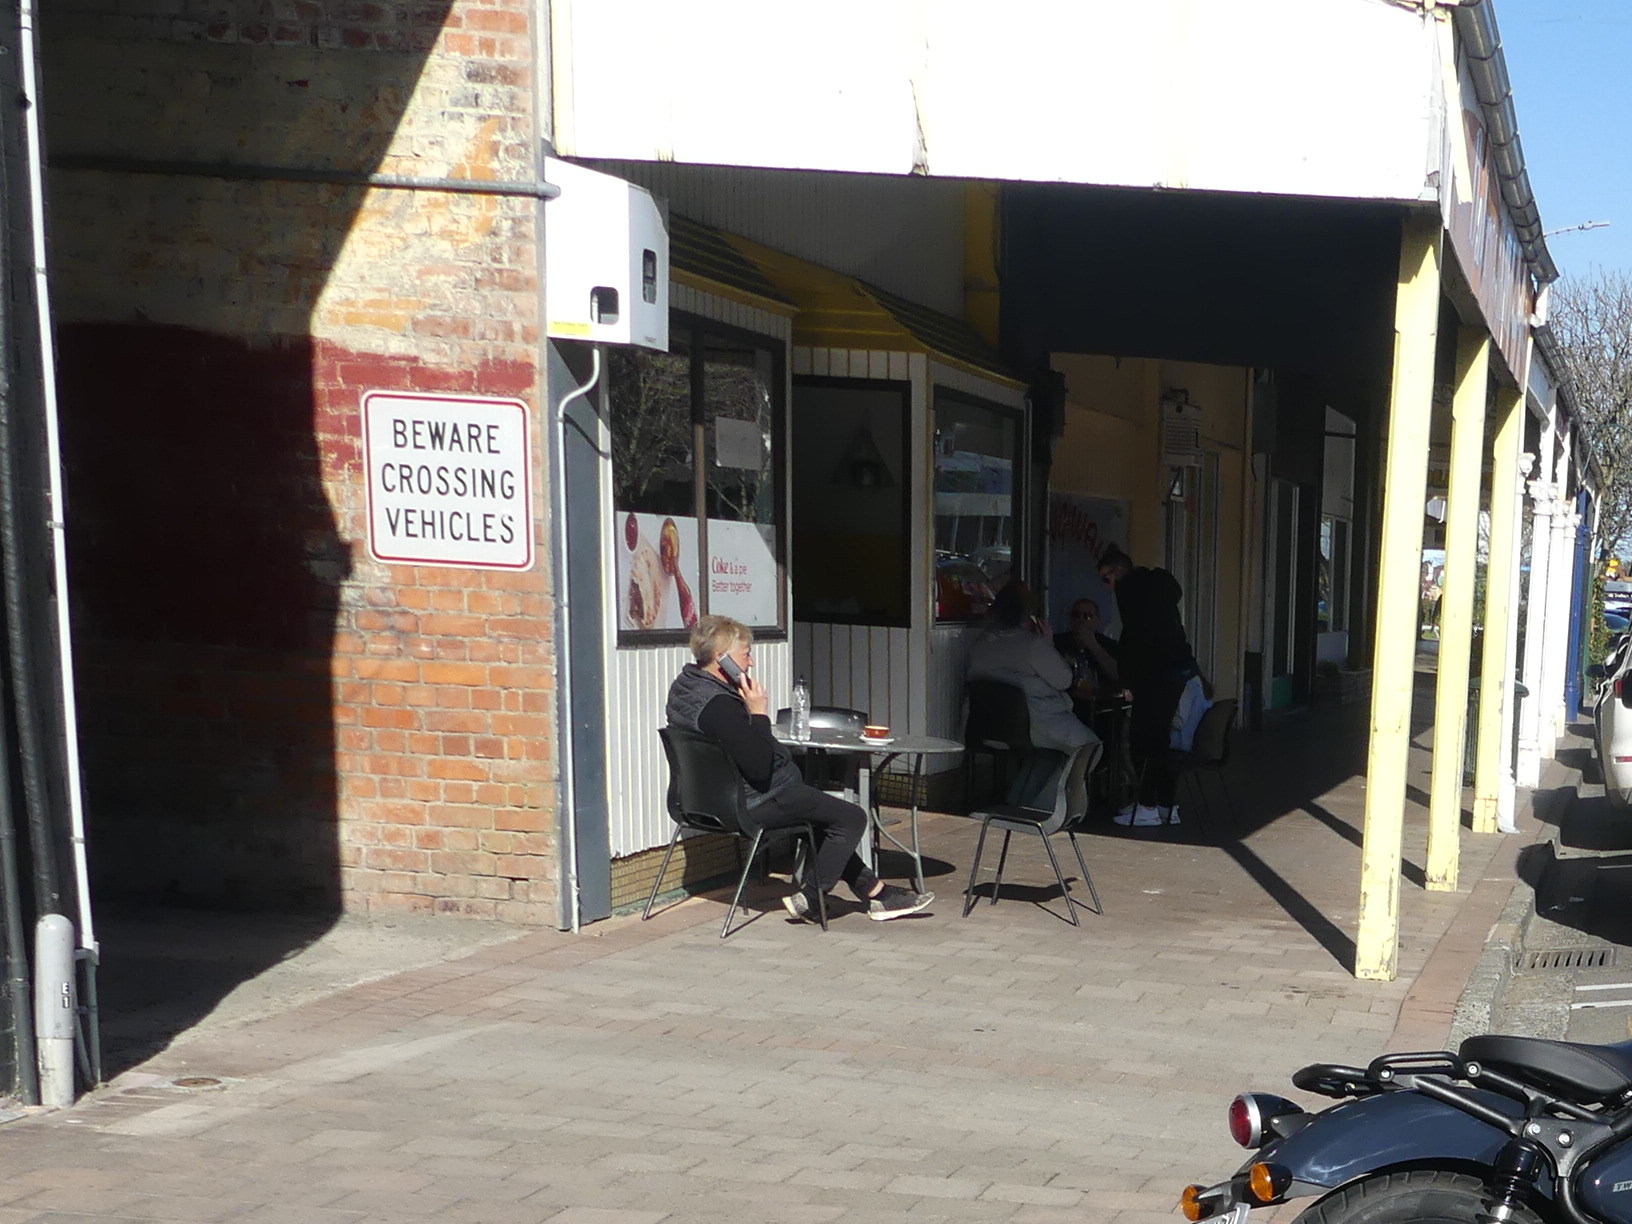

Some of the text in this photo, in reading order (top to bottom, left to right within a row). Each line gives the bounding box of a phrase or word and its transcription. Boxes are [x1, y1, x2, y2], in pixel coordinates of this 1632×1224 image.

[393, 418, 501, 454] BEWARE
[381, 462, 515, 500] CROSSING
[385, 507, 514, 544] VEHICLES
